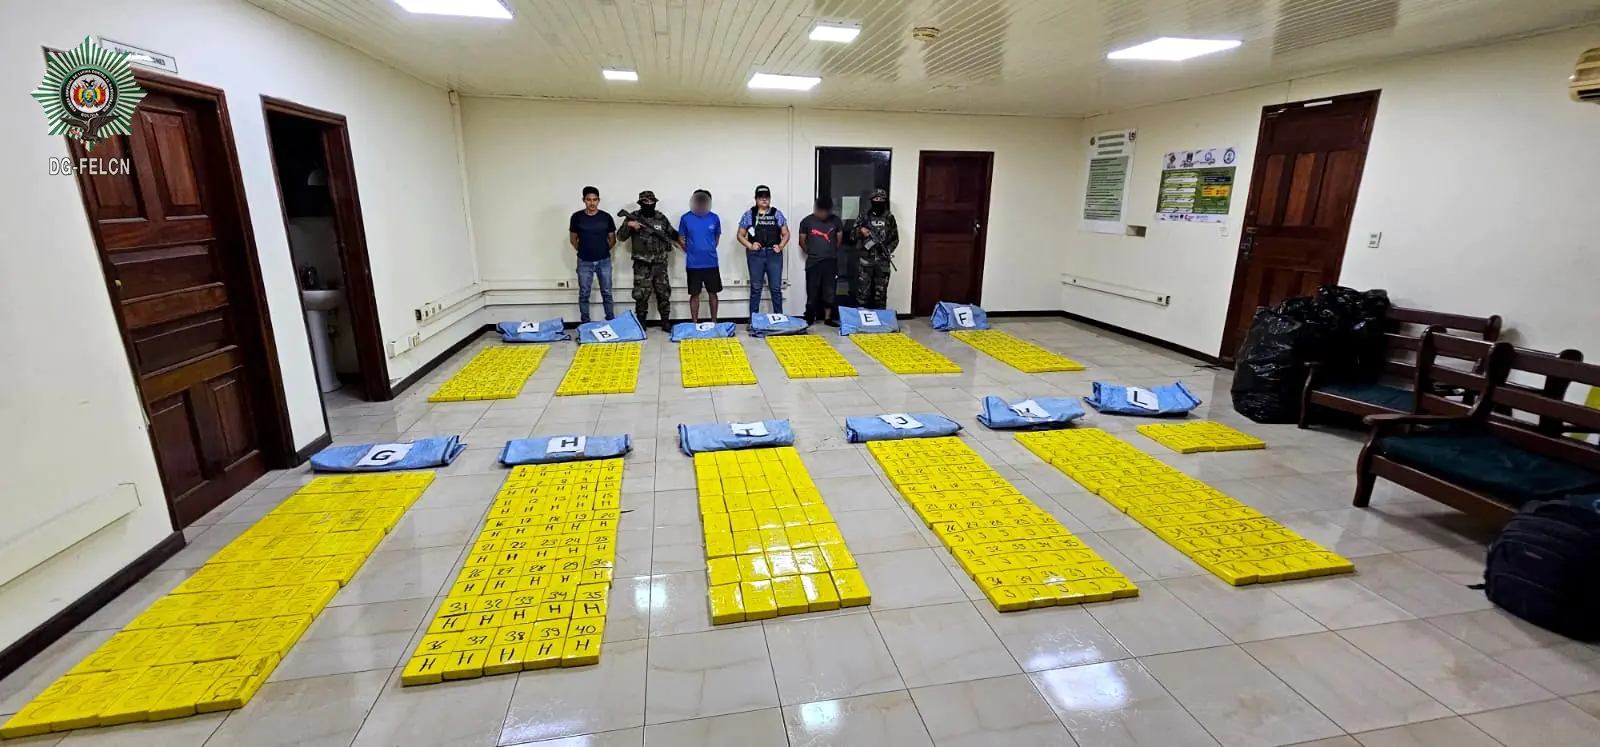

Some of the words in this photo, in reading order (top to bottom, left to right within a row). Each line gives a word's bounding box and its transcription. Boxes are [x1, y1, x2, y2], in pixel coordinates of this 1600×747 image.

[864, 314, 873, 322] E
[958, 312, 967, 324] F
[1133, 390, 1148, 406] L
[895, 416, 908, 424] J
[561, 437, 578, 447] H
[371, 450, 396, 461] G
[1279, 559, 1295, 568] K
[1322, 554, 1338, 563] K
[1224, 562, 1244, 574] K
[1252, 560, 1269, 571] K
[1066, 568, 1086, 577] 39
[1092, 567, 1114, 576] 40
[530, 577, 540, 585] H
[450, 603, 467, 611] 31
[484, 600, 502, 608] 32
[550, 605, 561, 613] H
[584, 604, 600, 614] H
[480, 615, 494, 625] H
[514, 611, 525, 620] H
[443, 618, 456, 628] H
[468, 636, 487, 644] 37
[504, 632, 524, 641] 38
[539, 644, 552, 655] H
[576, 640, 590, 650] H
[458, 653, 473, 664] H
[500, 649, 514, 661] H
[419, 659, 436, 671] H
